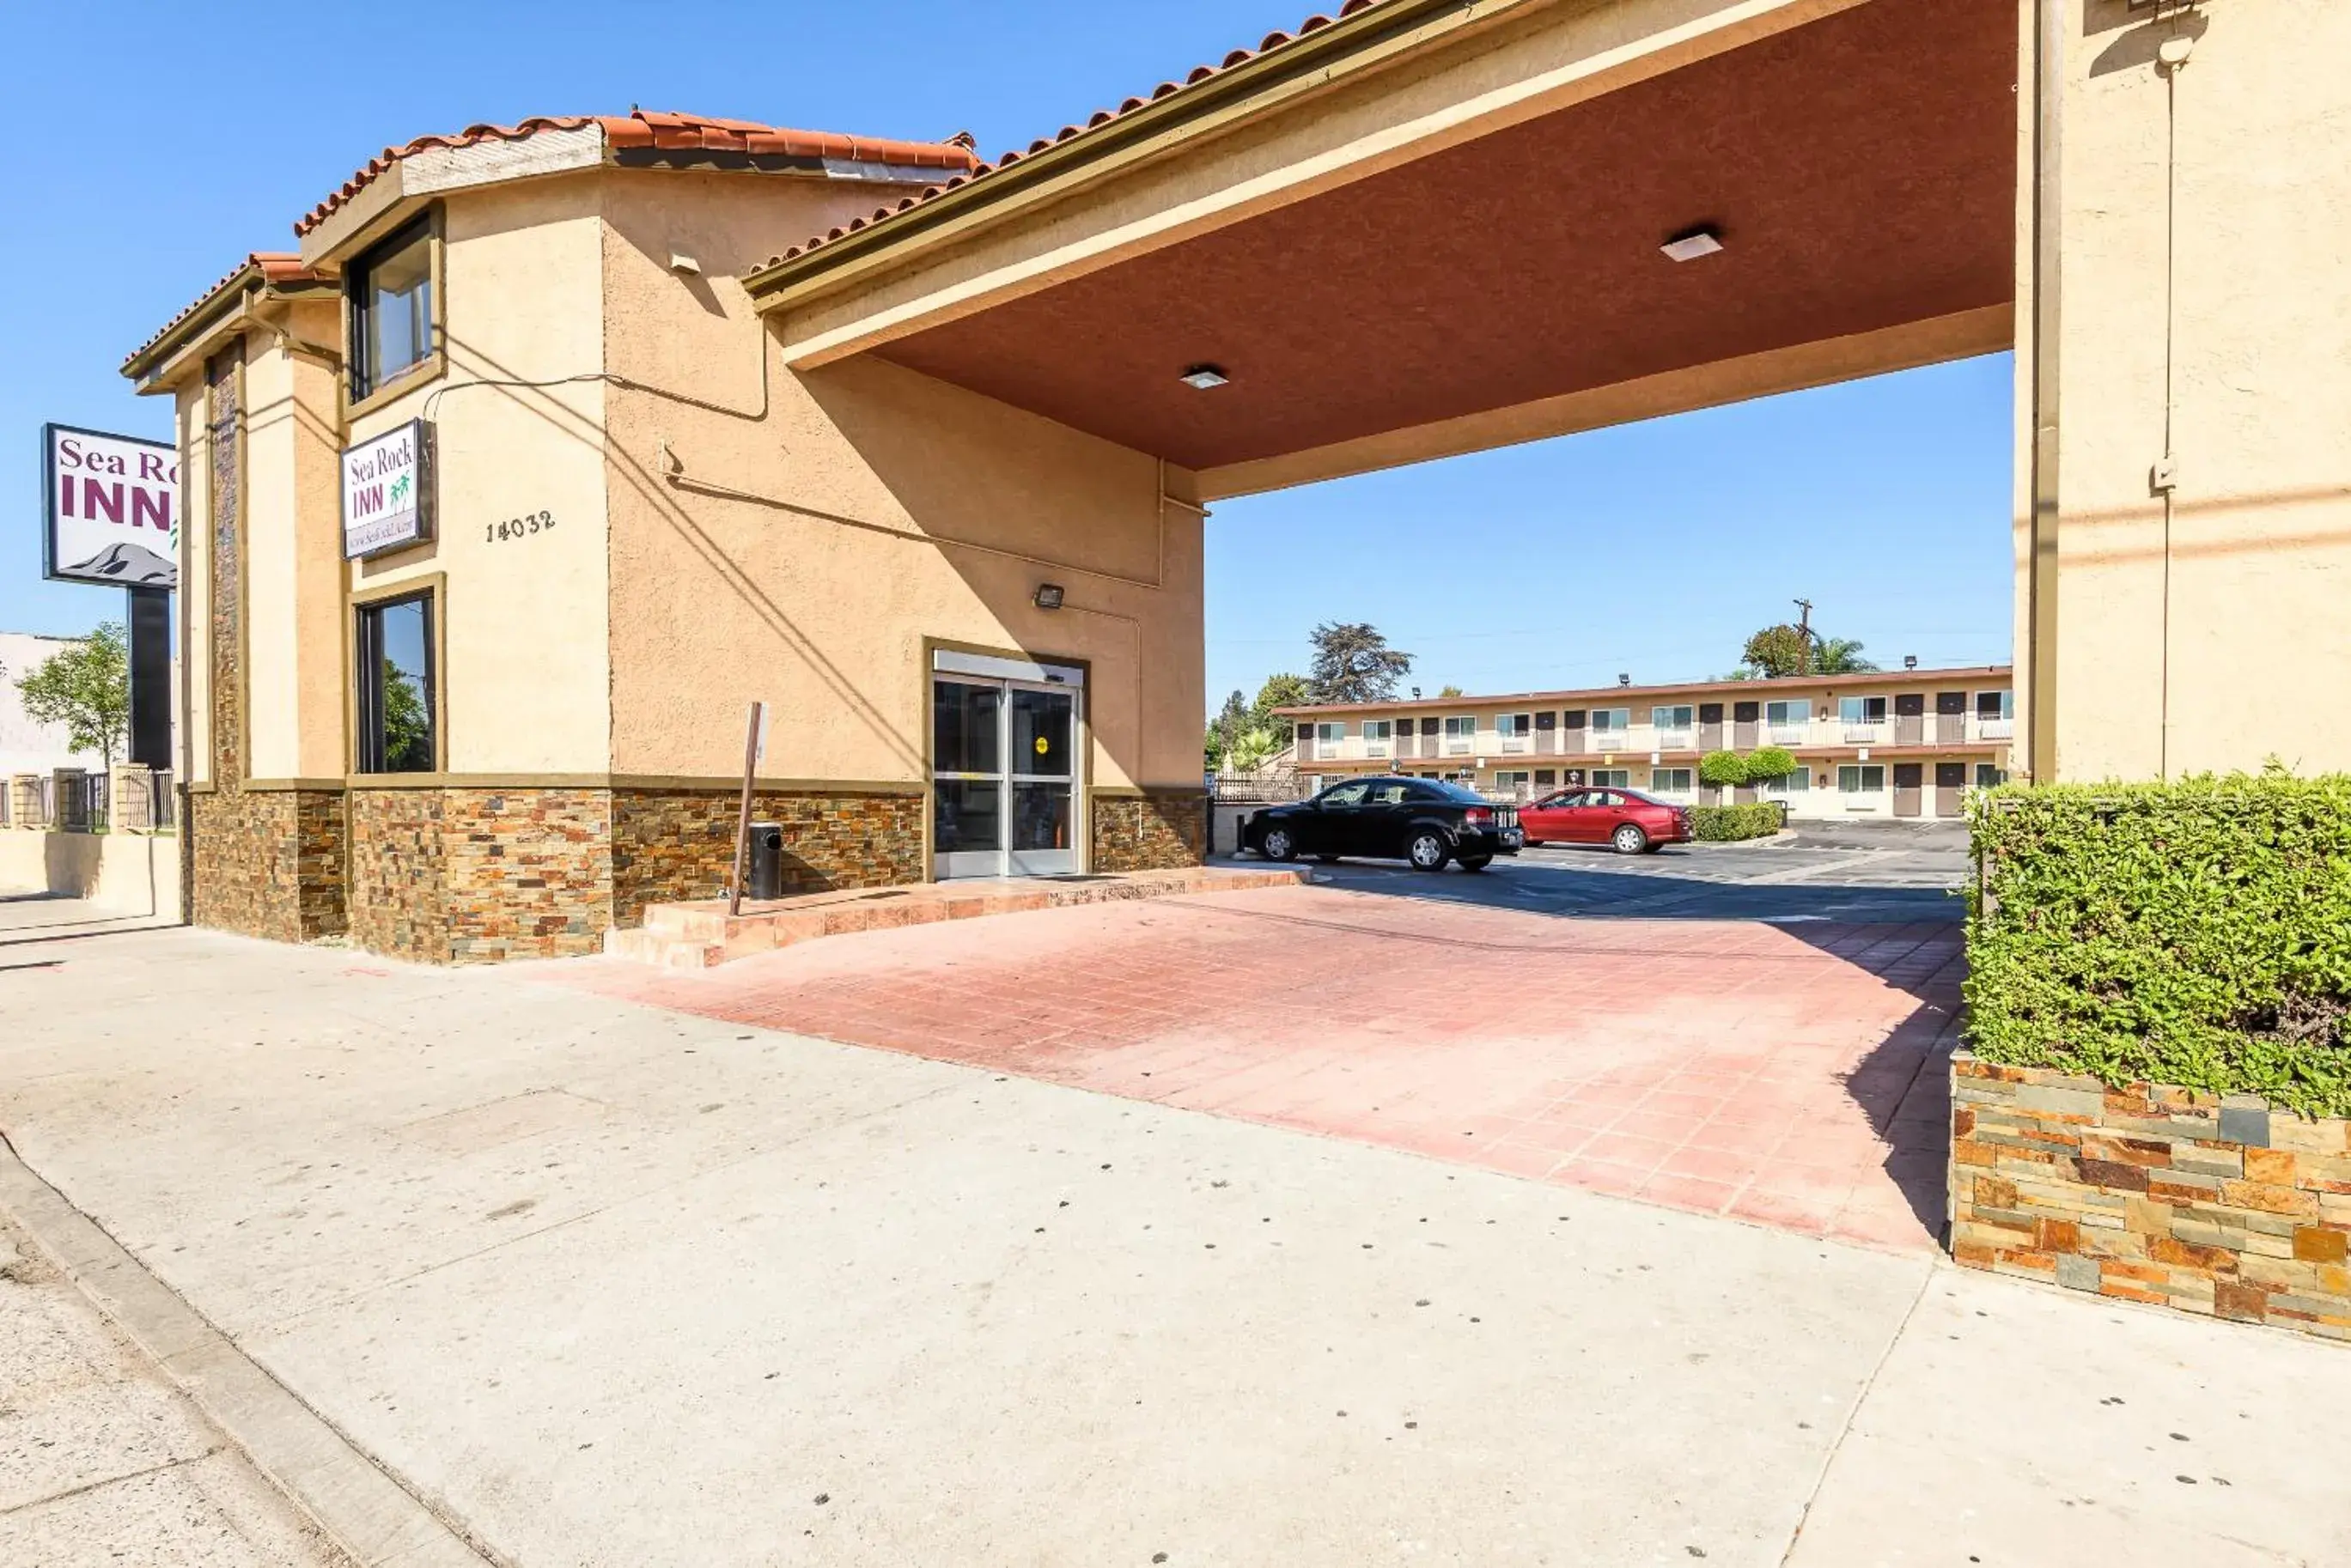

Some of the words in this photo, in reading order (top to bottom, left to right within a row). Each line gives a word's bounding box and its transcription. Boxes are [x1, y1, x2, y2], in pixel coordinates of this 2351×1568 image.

[59, 439, 125, 475] Sea
[350, 458, 375, 485] Sea
[376, 438, 412, 476] Rock
[62, 474, 170, 532] INN
[353, 483, 383, 520] INN
[486, 510, 556, 543] 14032
